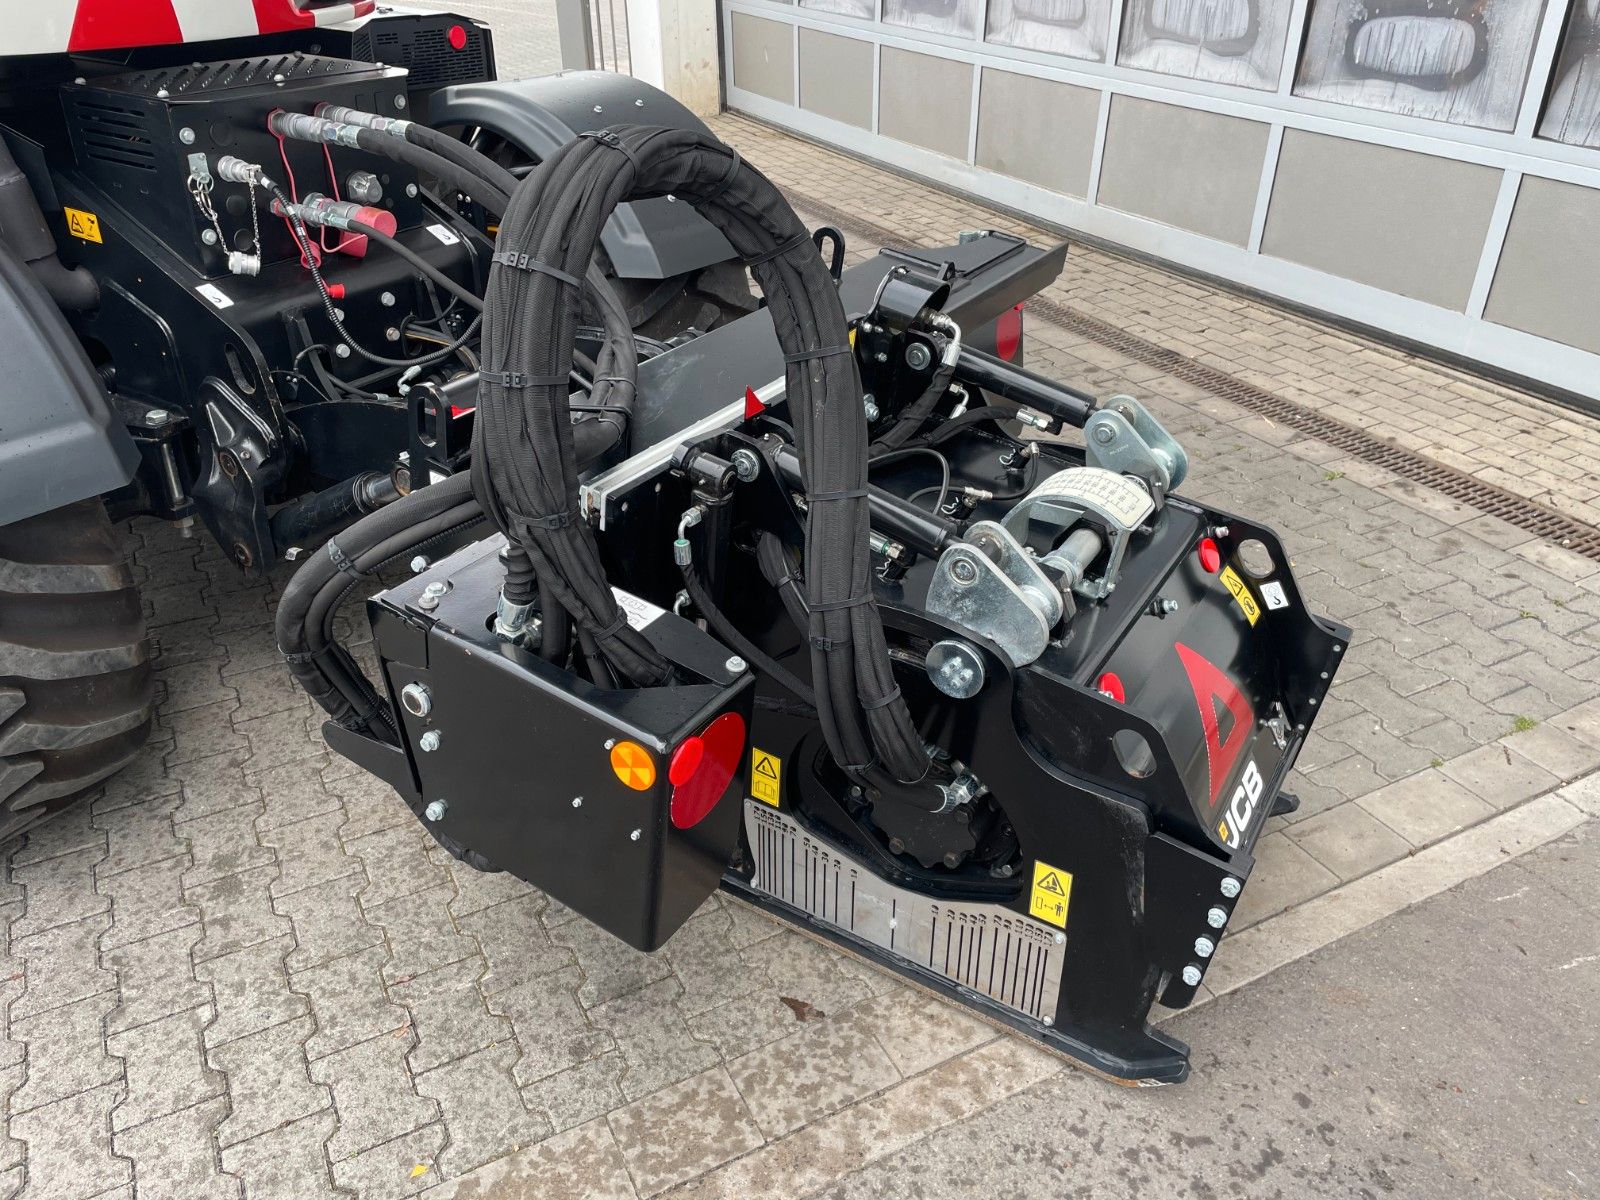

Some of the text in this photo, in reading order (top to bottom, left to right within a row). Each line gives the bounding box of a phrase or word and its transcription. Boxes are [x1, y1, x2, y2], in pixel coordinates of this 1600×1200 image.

[1225, 760, 1263, 849] JCB
[803, 837, 810, 848] 50
[821, 851, 829, 863] 30
[833, 859, 841, 870] 20
[850, 868, 858, 879] 10
[931, 904, 939, 915] 10
[947, 909, 955, 920] 20
[959, 912, 967, 923] 30
[993, 914, 1002, 926] 70
